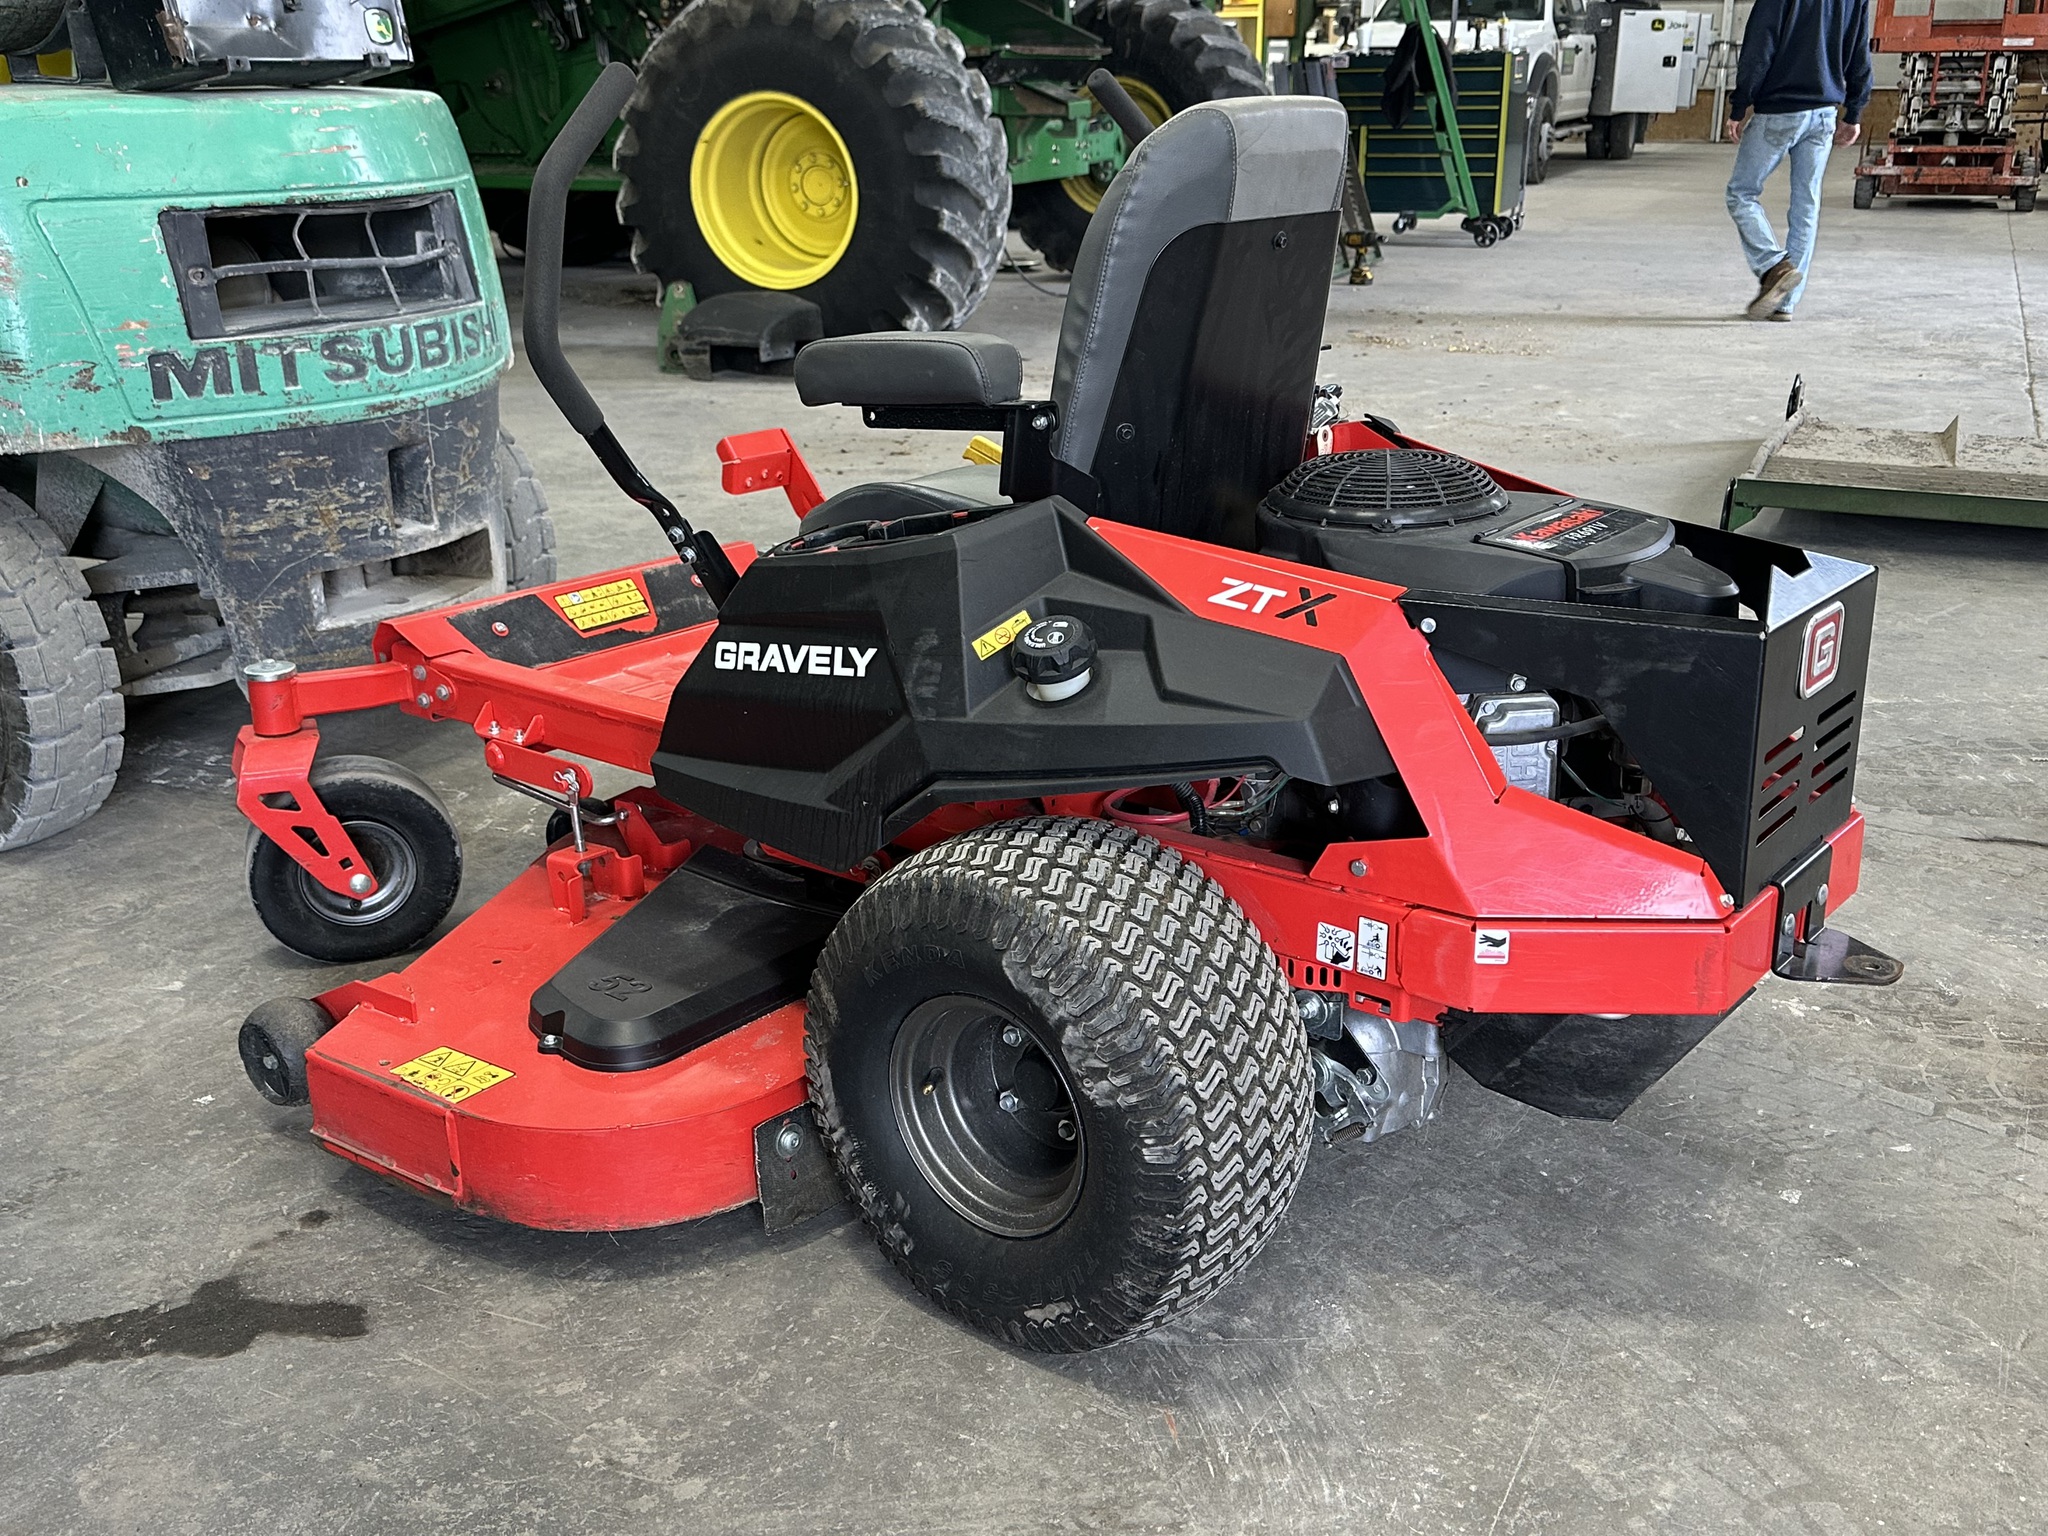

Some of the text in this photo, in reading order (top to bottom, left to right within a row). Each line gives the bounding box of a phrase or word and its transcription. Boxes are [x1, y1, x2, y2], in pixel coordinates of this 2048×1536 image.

[1512, 507, 1605, 542] Kawasaki
[714, 640, 878, 678] GRAVELY
[862, 944, 967, 988] KENDA
[587, 975, 653, 1002] 52
